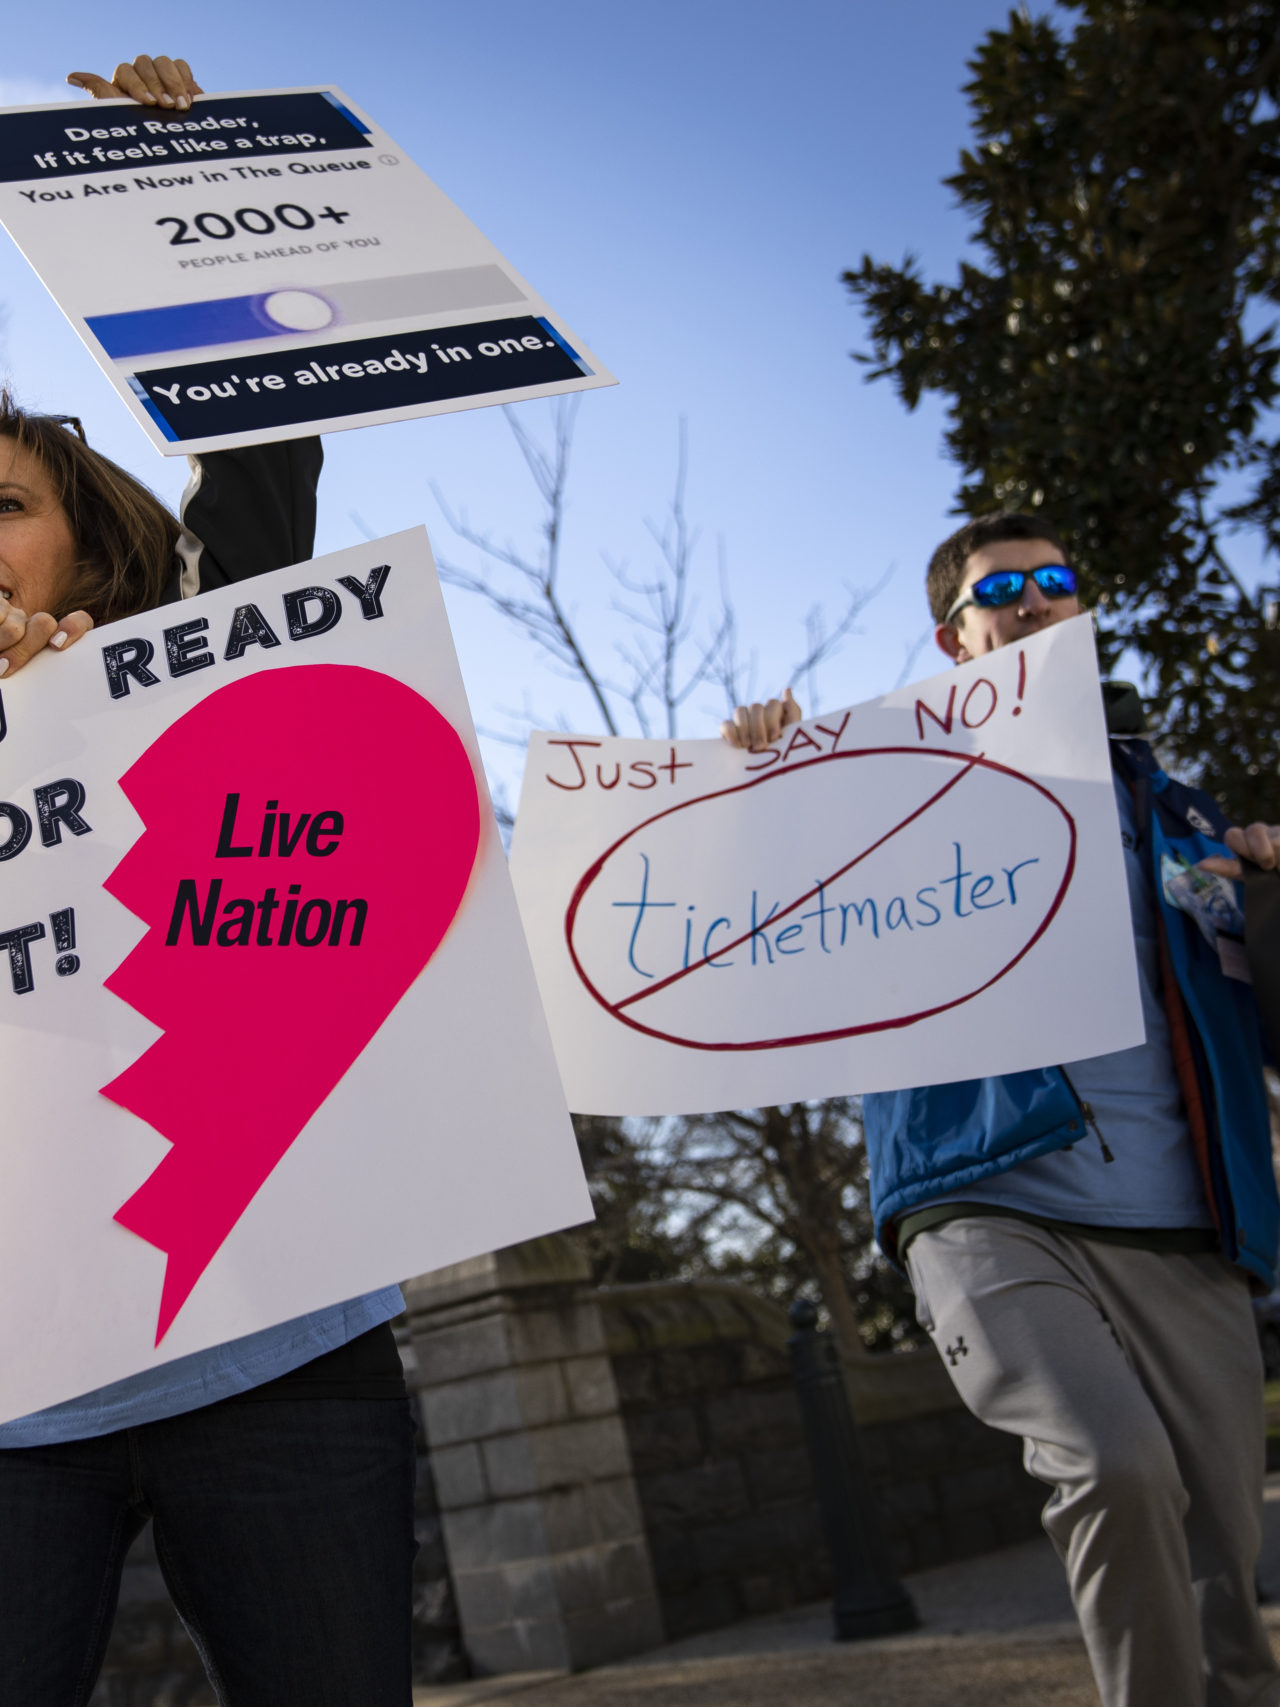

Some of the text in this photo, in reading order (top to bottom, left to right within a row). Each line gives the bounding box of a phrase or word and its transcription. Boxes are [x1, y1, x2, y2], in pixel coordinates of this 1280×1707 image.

[34, 131, 326, 169] If it feels like a trap,
[64, 114, 259, 142] Dear Reader,
[19, 156, 372, 204] You Are Now in The Queue
[155, 203, 350, 246] 2000+
[178, 237, 382, 269] PEOPLE AHEAD OF YOU
[153, 332, 556, 405] You're already in one.
[102, 564, 392, 699] READY
[745, 712, 851, 770] SAY
[915, 650, 1026, 740] NO!
[214, 792, 345, 858] Live
[165, 879, 369, 946] Nation
[612, 842, 1040, 979] ticketmaster
